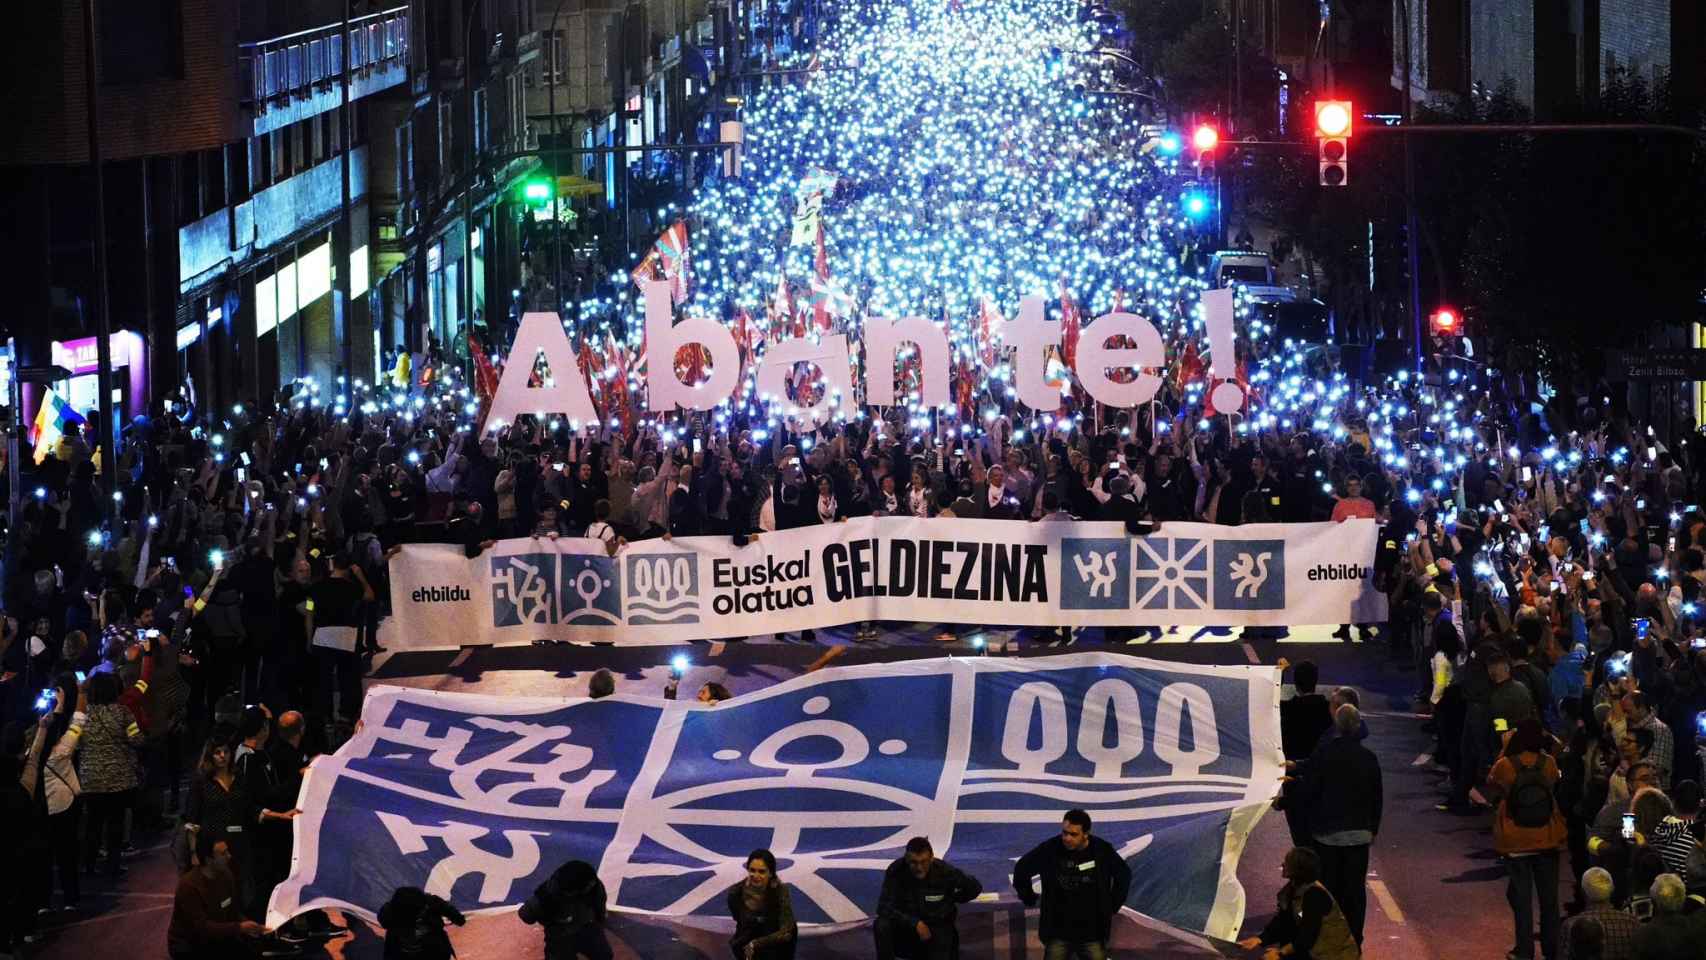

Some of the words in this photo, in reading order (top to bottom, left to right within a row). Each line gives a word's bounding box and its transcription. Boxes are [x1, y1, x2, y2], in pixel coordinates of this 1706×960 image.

[478, 280, 1243, 443] Abante!
[712, 550, 810, 588] Euskal
[822, 538, 1048, 603] GELDIEZINA
[1307, 564, 1367, 581] ehbildu
[412, 586, 471, 603] ehbildu
[712, 585, 814, 616] olatua
